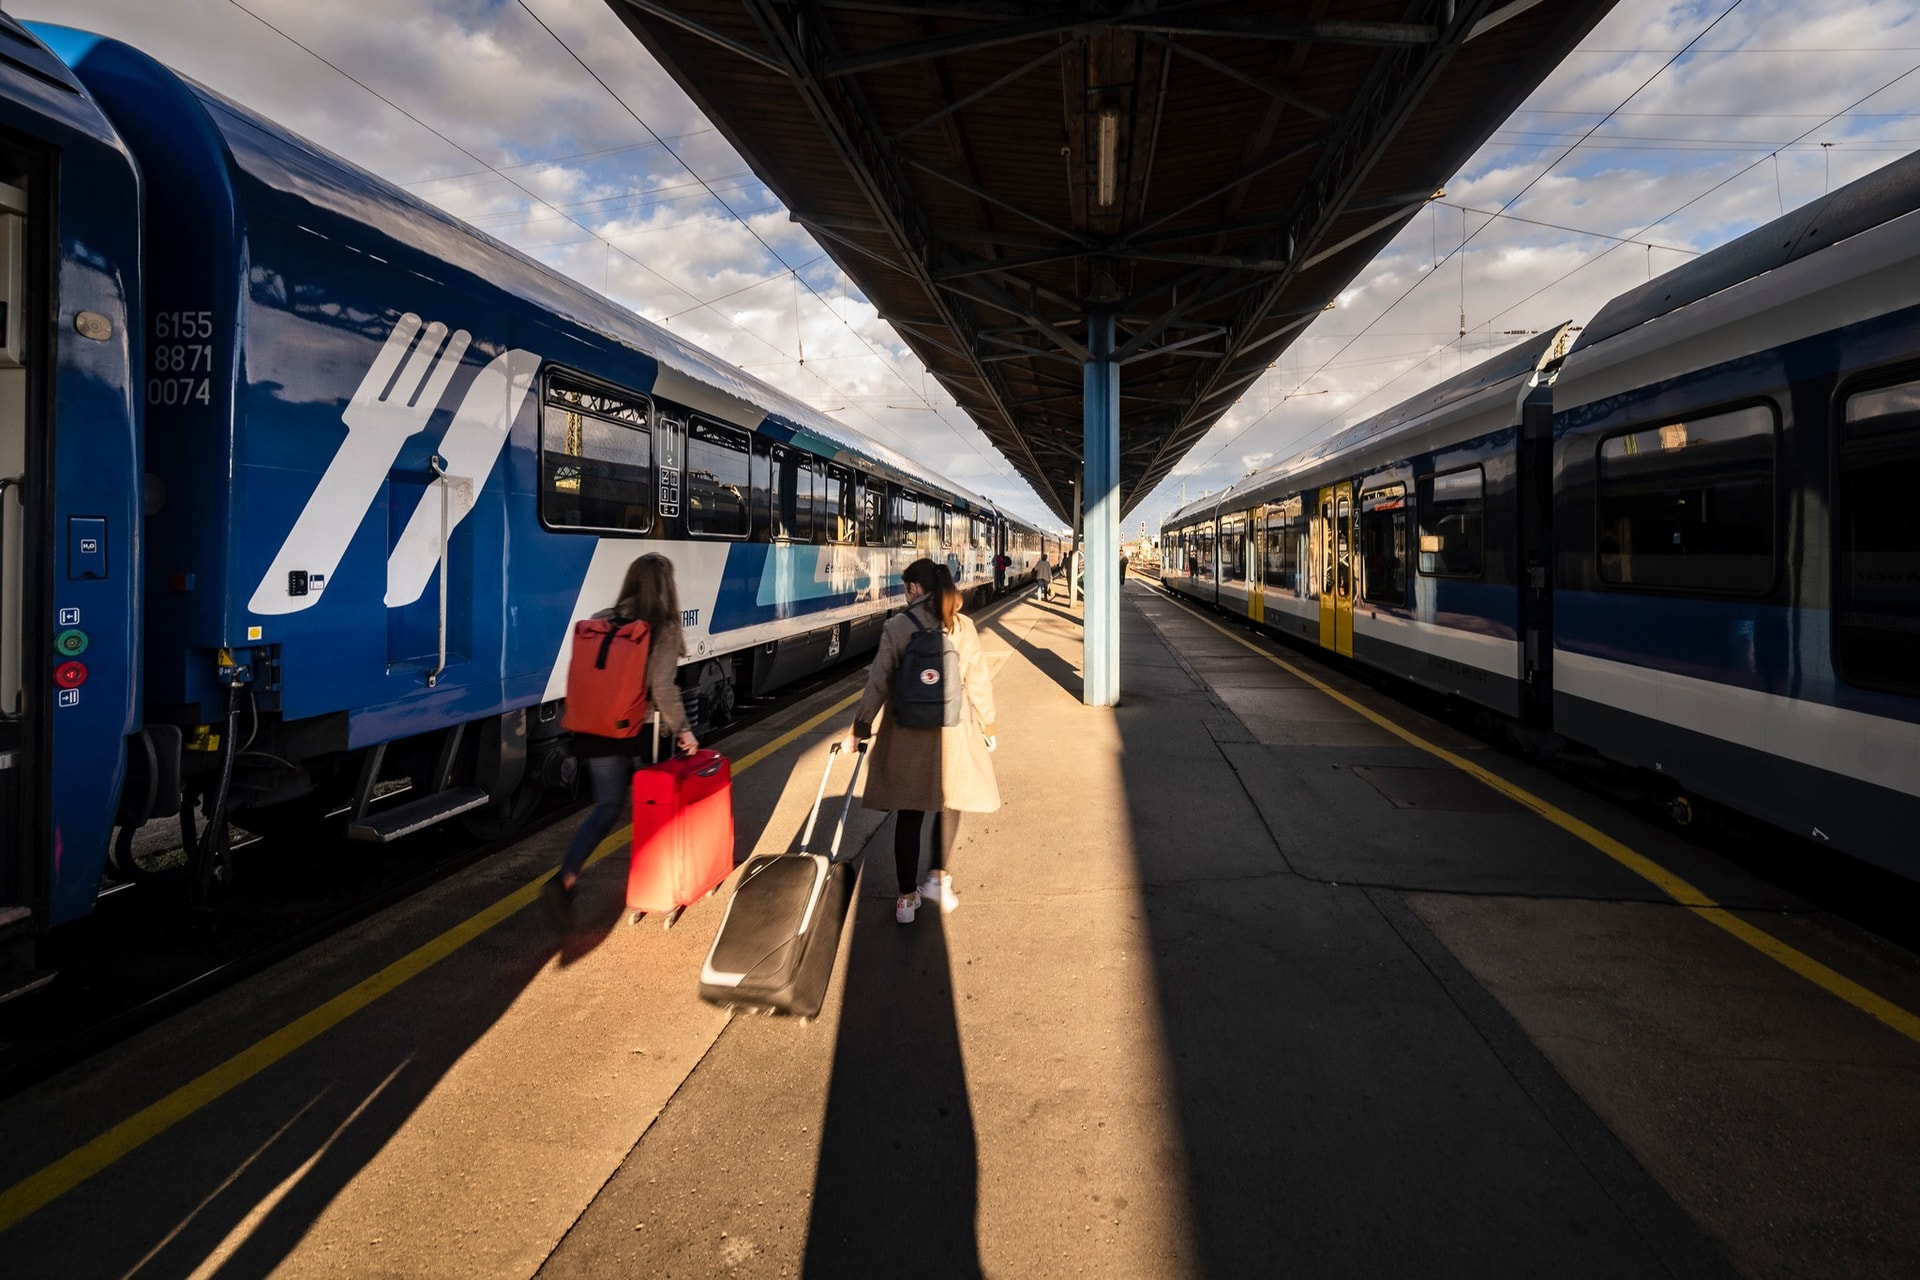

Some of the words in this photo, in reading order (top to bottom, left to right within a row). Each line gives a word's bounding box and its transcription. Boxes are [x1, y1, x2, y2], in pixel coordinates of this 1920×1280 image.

[155, 311, 212, 338] 6155
[155, 344, 212, 372] 8871
[147, 378, 210, 405] 0074
[1354, 510, 1359, 527] 2
[681, 608, 699, 627] ART
